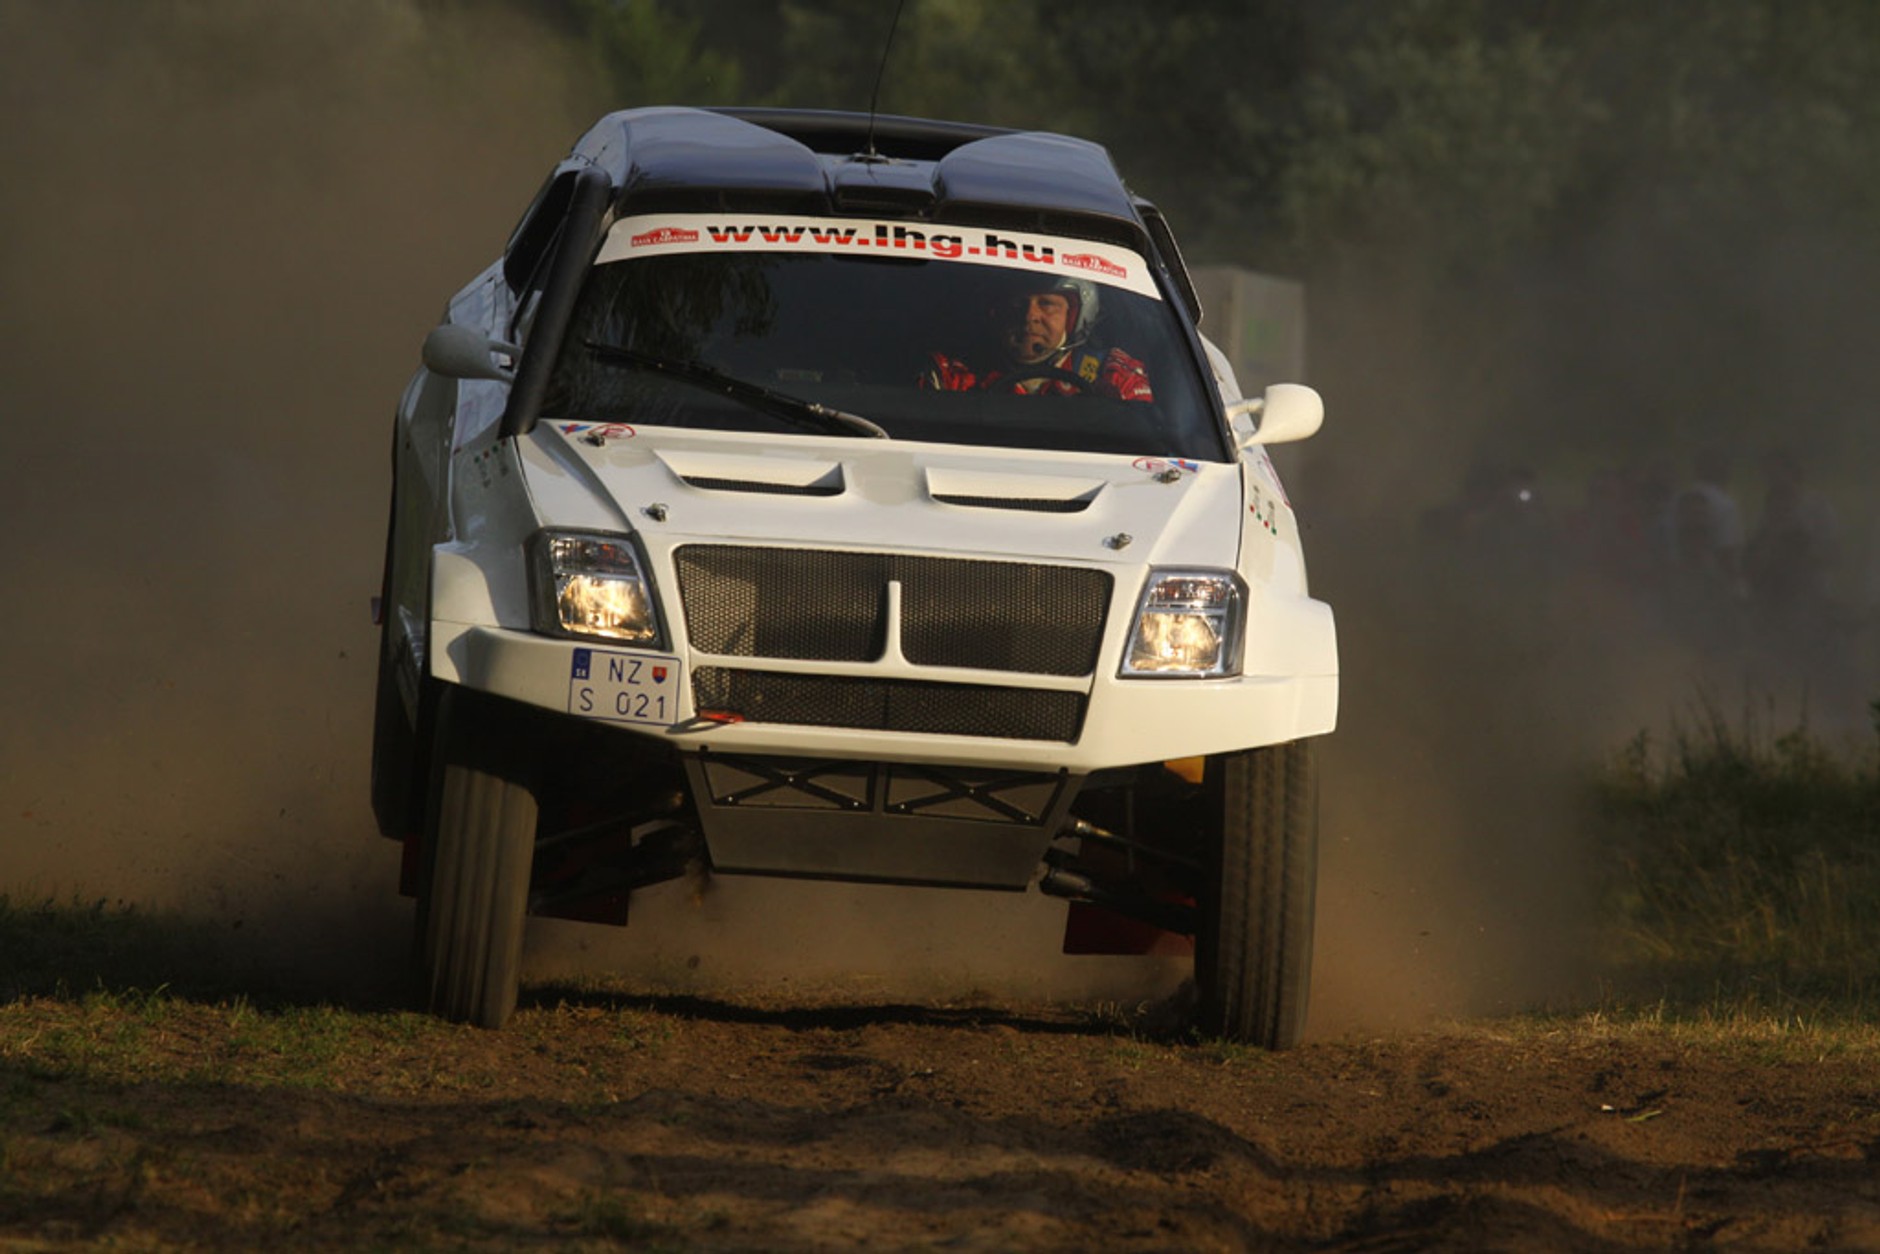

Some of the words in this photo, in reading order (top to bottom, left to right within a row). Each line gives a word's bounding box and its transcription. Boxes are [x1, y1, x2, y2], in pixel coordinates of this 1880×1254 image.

[707, 224, 1055, 264] www.lhg.hu
[609, 657, 642, 684] NZ
[579, 687, 594, 712] S
[615, 691, 665, 720] 021
